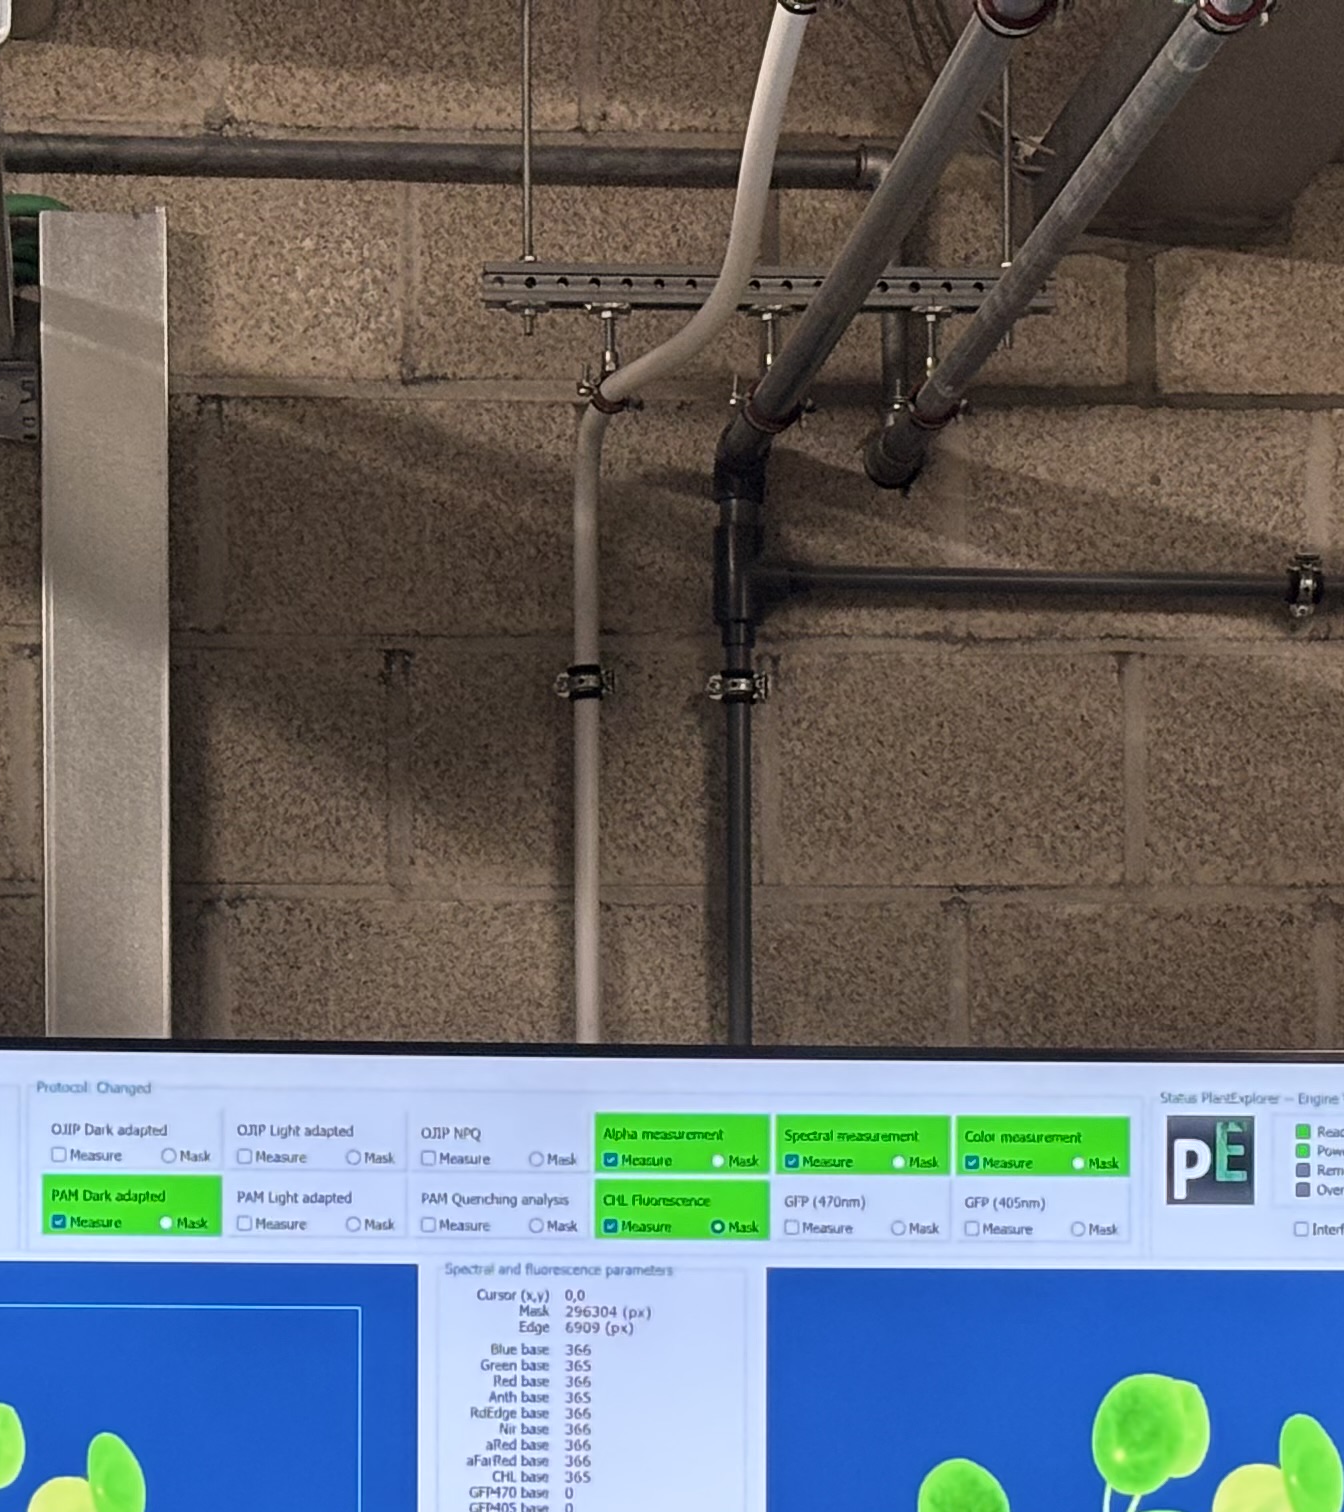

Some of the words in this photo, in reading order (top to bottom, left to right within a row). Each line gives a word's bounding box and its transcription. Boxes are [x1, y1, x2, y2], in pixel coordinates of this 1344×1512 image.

[97, 1082, 151, 1096] Changed
[1298, 1093, 1339, 1108] Engine
[84, 1124, 114, 1137] Dark
[117, 1124, 167, 1139] adapted
[270, 1124, 300, 1140] Light
[304, 1124, 354, 1140] adapted
[604, 1127, 638, 1142] Alpha
[70, 1149, 122, 1162] Measure
[180, 1149, 210, 1162] Mask
[51, 1189, 79, 1202] PAM
[83, 1189, 112, 1202] Dark
[115, 1189, 166, 1205] adapted
[784, 1195, 809, 1209] GFP
[813, 1194, 866, 1211] (470nm)
[70, 1216, 121, 1229] Measure
[177, 1217, 208, 1229] Mask
[445, 1264, 494, 1277] Spectral
[498, 1264, 521, 1276] and
[526, 1264, 601, 1276] fluorescence
[606, 1264, 673, 1278] parameters
[477, 1290, 517, 1301] Cursor
[519, 1305, 550, 1317] Mask
[565, 1306, 617, 1318] 296304
[623, 1306, 651, 1320] (px)
[519, 1321, 550, 1335] Edge
[565, 1322, 600, 1334] 6909
[605, 1322, 634, 1335] (px)
